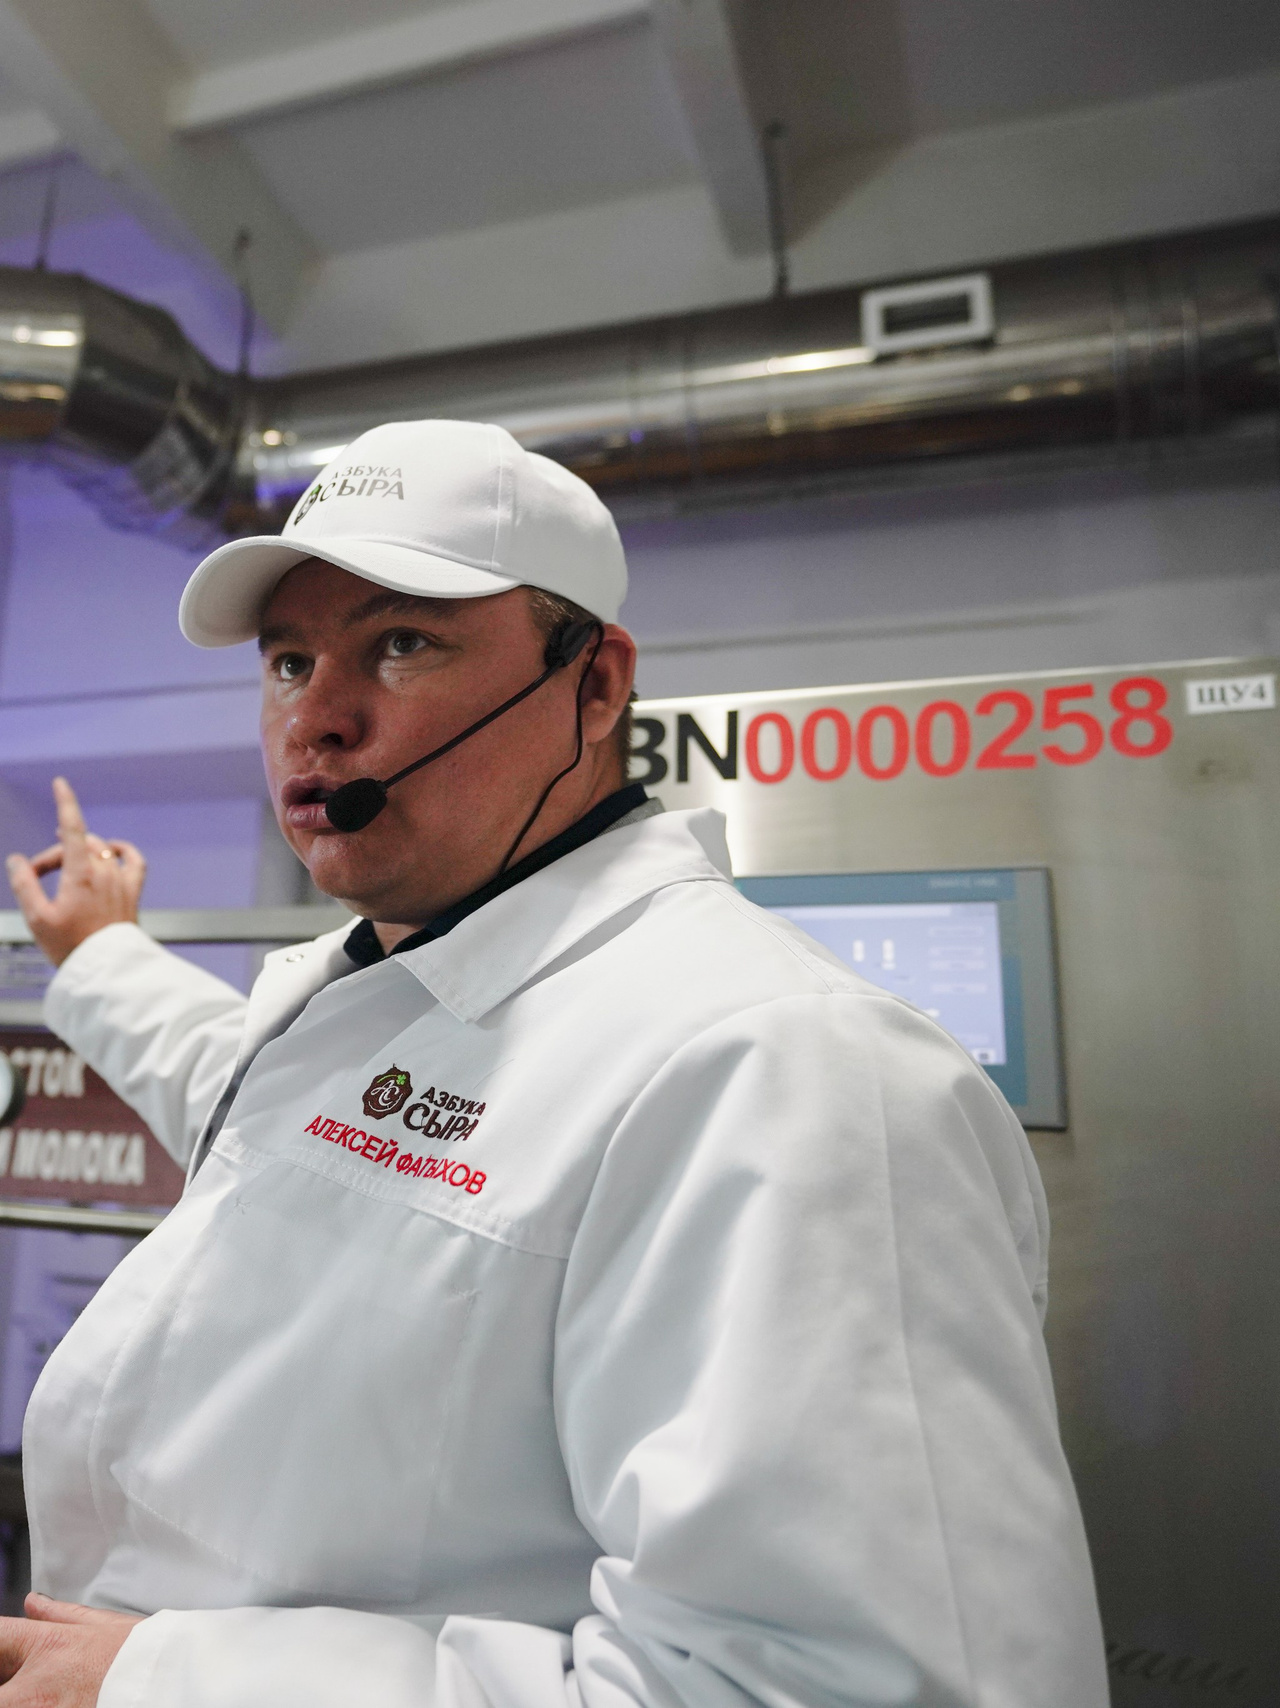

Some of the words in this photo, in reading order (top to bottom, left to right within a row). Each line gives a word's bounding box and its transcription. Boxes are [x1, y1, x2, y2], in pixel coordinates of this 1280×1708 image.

[320, 478, 405, 502] СЫРА
[331, 466, 403, 480] АЗБУКА
[420, 1086, 487, 1117] АЗБУКА
[403, 1102, 480, 1142] СЫРА
[12, 1127, 146, 1185] МОЛОКА
[304, 1115, 399, 1168] АЛЕКСЕЙ
[396, 1153, 487, 1195] ФАТЫХОВ
